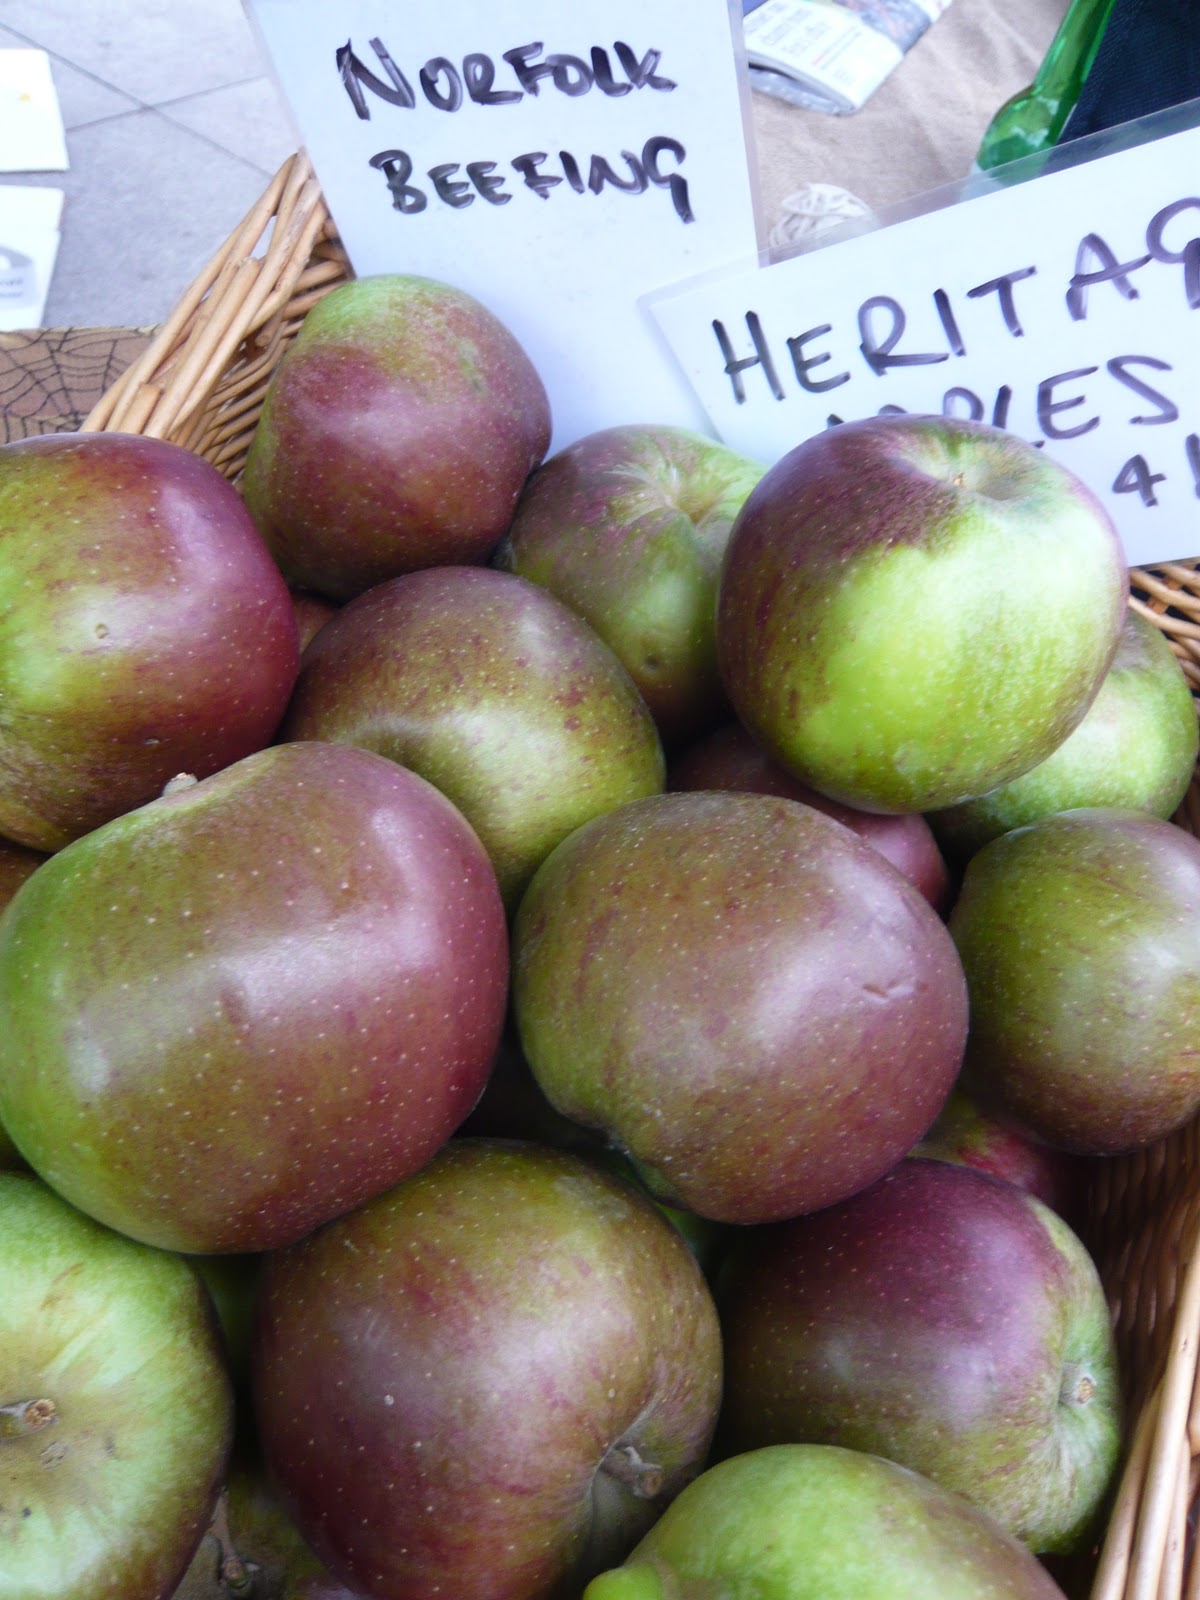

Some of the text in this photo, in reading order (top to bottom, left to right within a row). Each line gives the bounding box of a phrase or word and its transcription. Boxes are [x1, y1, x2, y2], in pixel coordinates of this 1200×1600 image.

[336, 37, 679, 121] NORFOLK
[368, 135, 696, 225] BEEFING
[826, 354, 1180, 449] LES
